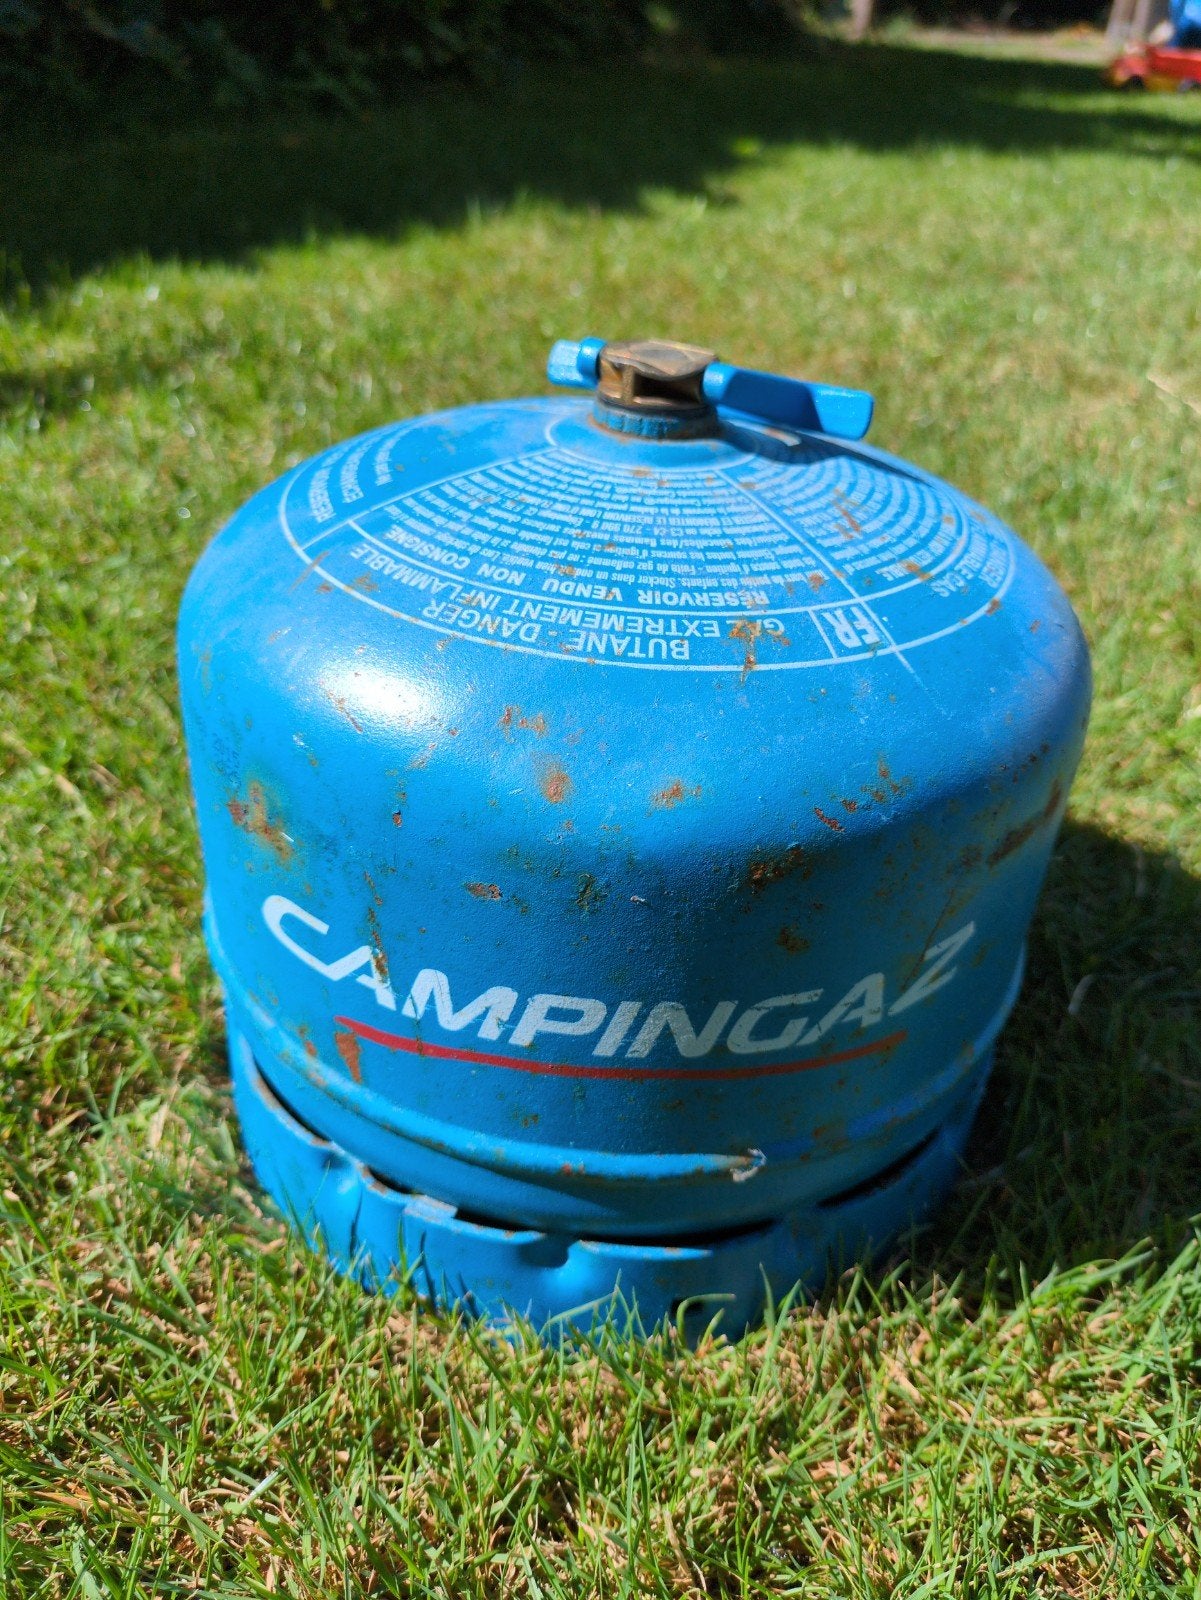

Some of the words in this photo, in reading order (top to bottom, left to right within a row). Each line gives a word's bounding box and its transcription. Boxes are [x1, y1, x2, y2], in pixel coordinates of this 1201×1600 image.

[348, 542, 501, 611] INFLAMMABLE
[479, 563, 527, 587] NON
[542, 577, 623, 602] VENDU
[610, 572, 635, 584] dans
[637, 575, 675, 587] Stocker
[423, 598, 542, 643] DANGER
[501, 598, 720, 638] EXTREMEMENT
[725, 617, 785, 638] GAZ
[823, 605, 880, 648] FR
[567, 629, 690, 661] BUTANE
[262, 894, 977, 1059] CAMPINGAZ
